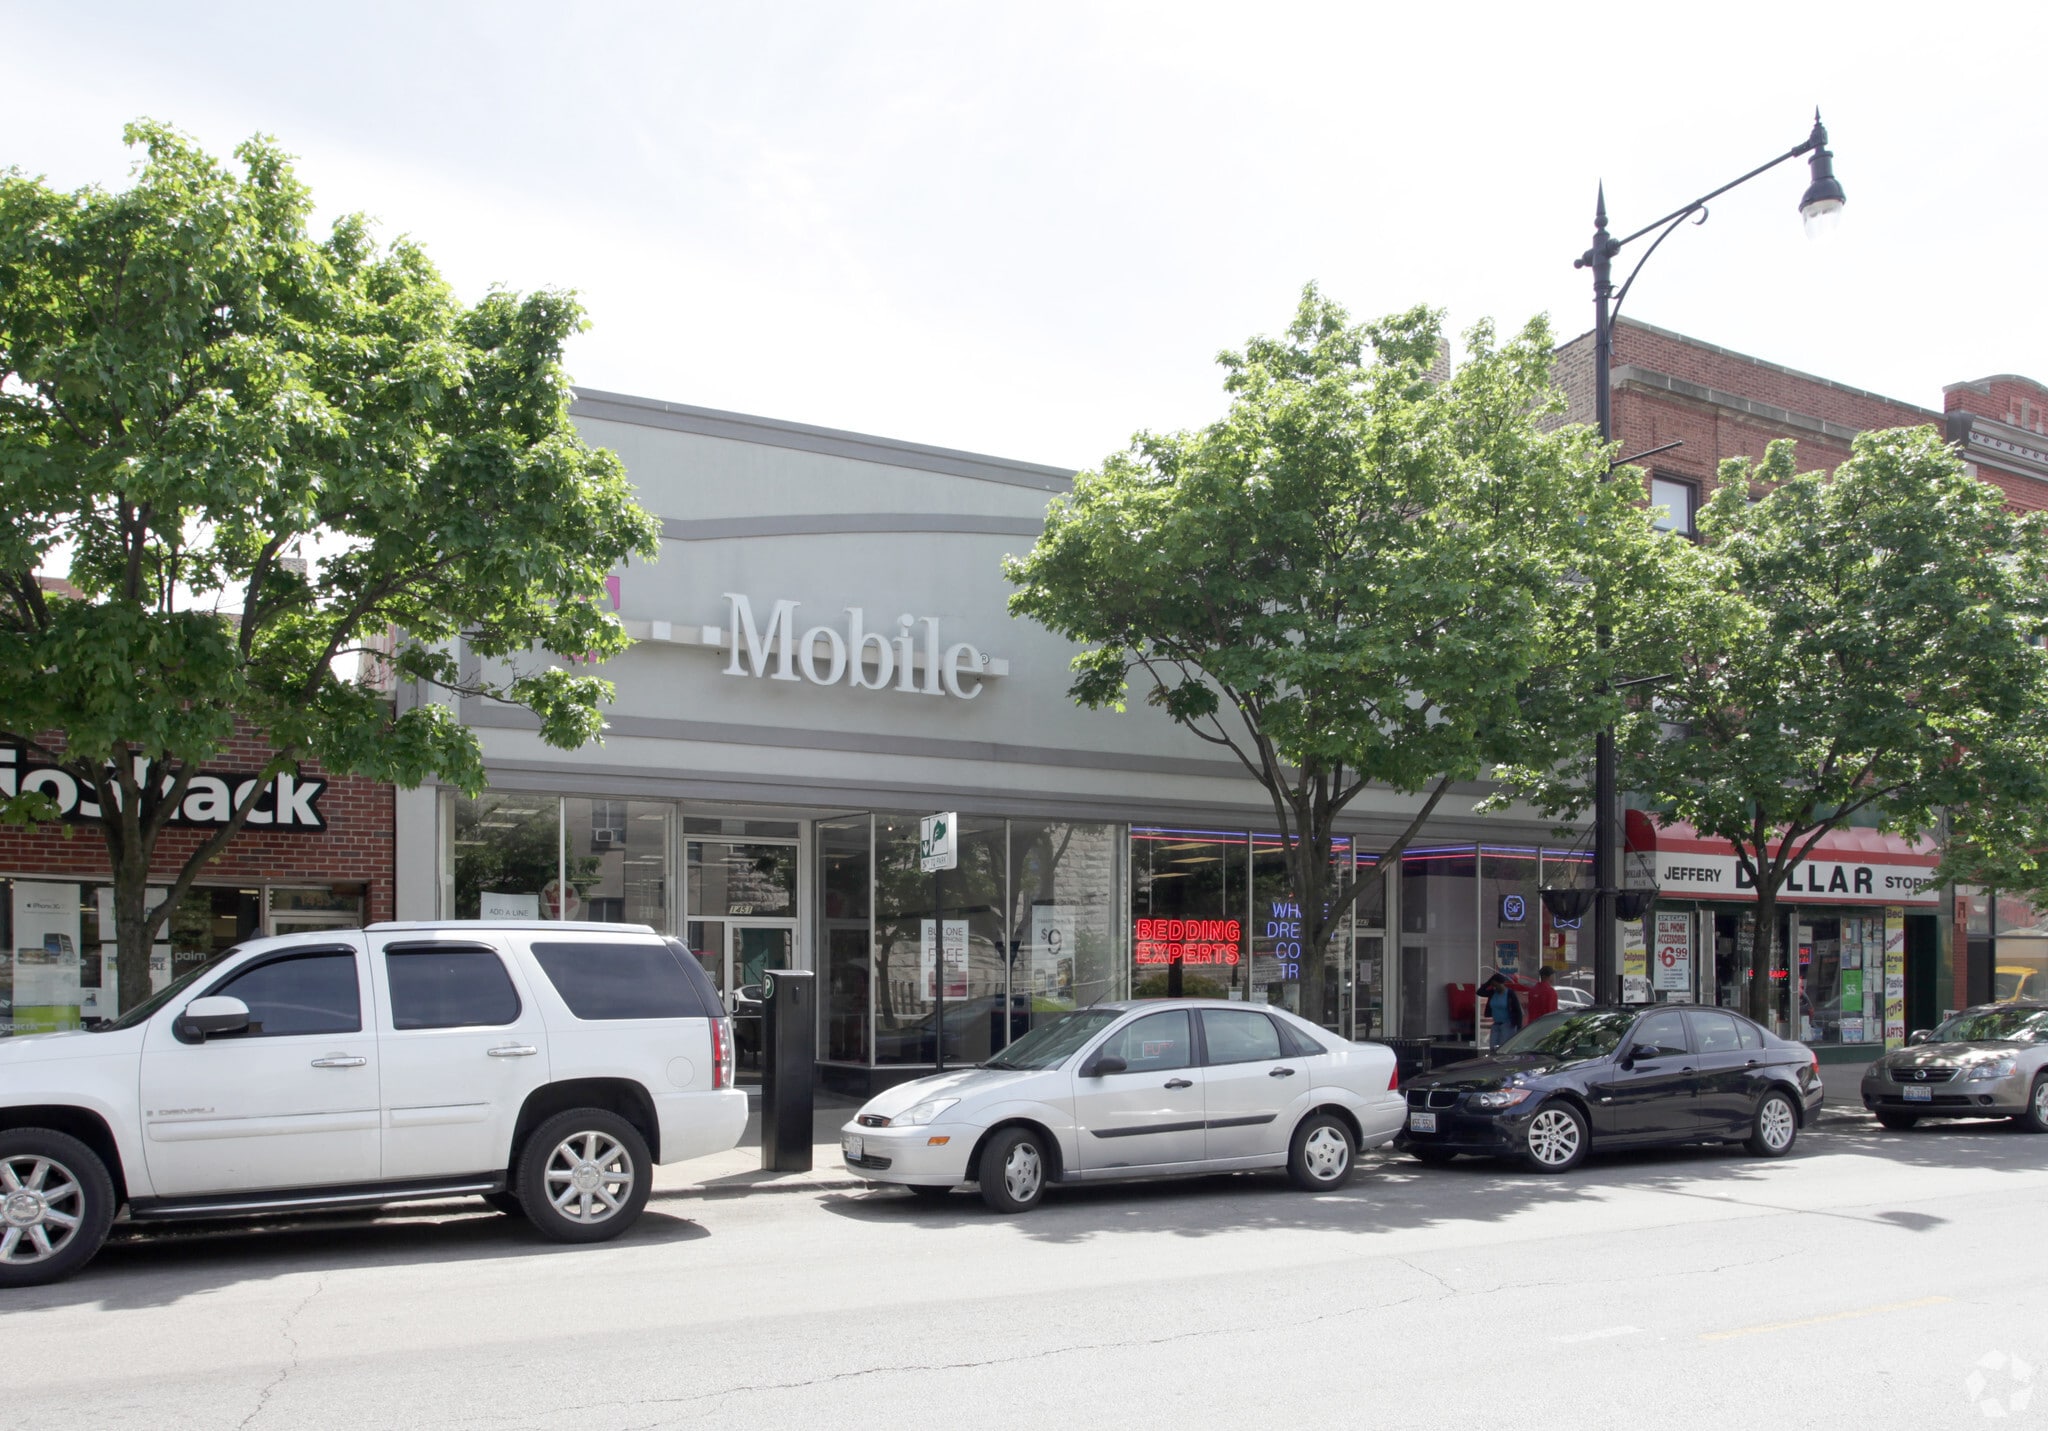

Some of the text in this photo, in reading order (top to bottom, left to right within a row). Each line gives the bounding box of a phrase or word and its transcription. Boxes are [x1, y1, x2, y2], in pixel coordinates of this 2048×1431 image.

[721, 592, 983, 700] Mobile
[1664, 866, 1722, 883] JEFFERY
[1735, 860, 1873, 894] DLLAR
[1886, 908, 1903, 919] Bed
[928, 926, 963, 936] BU ONE
[1135, 919, 1241, 942] BEDDING
[1658, 922, 1686, 933] CELL PHONE
[175, 951, 207, 963] palm
[928, 947, 963, 963] FEE
[1135, 942, 1240, 966] EXPERTS
[1886, 1000, 1904, 1019] TOYS
[1886, 1025, 1904, 1039] ARTS
